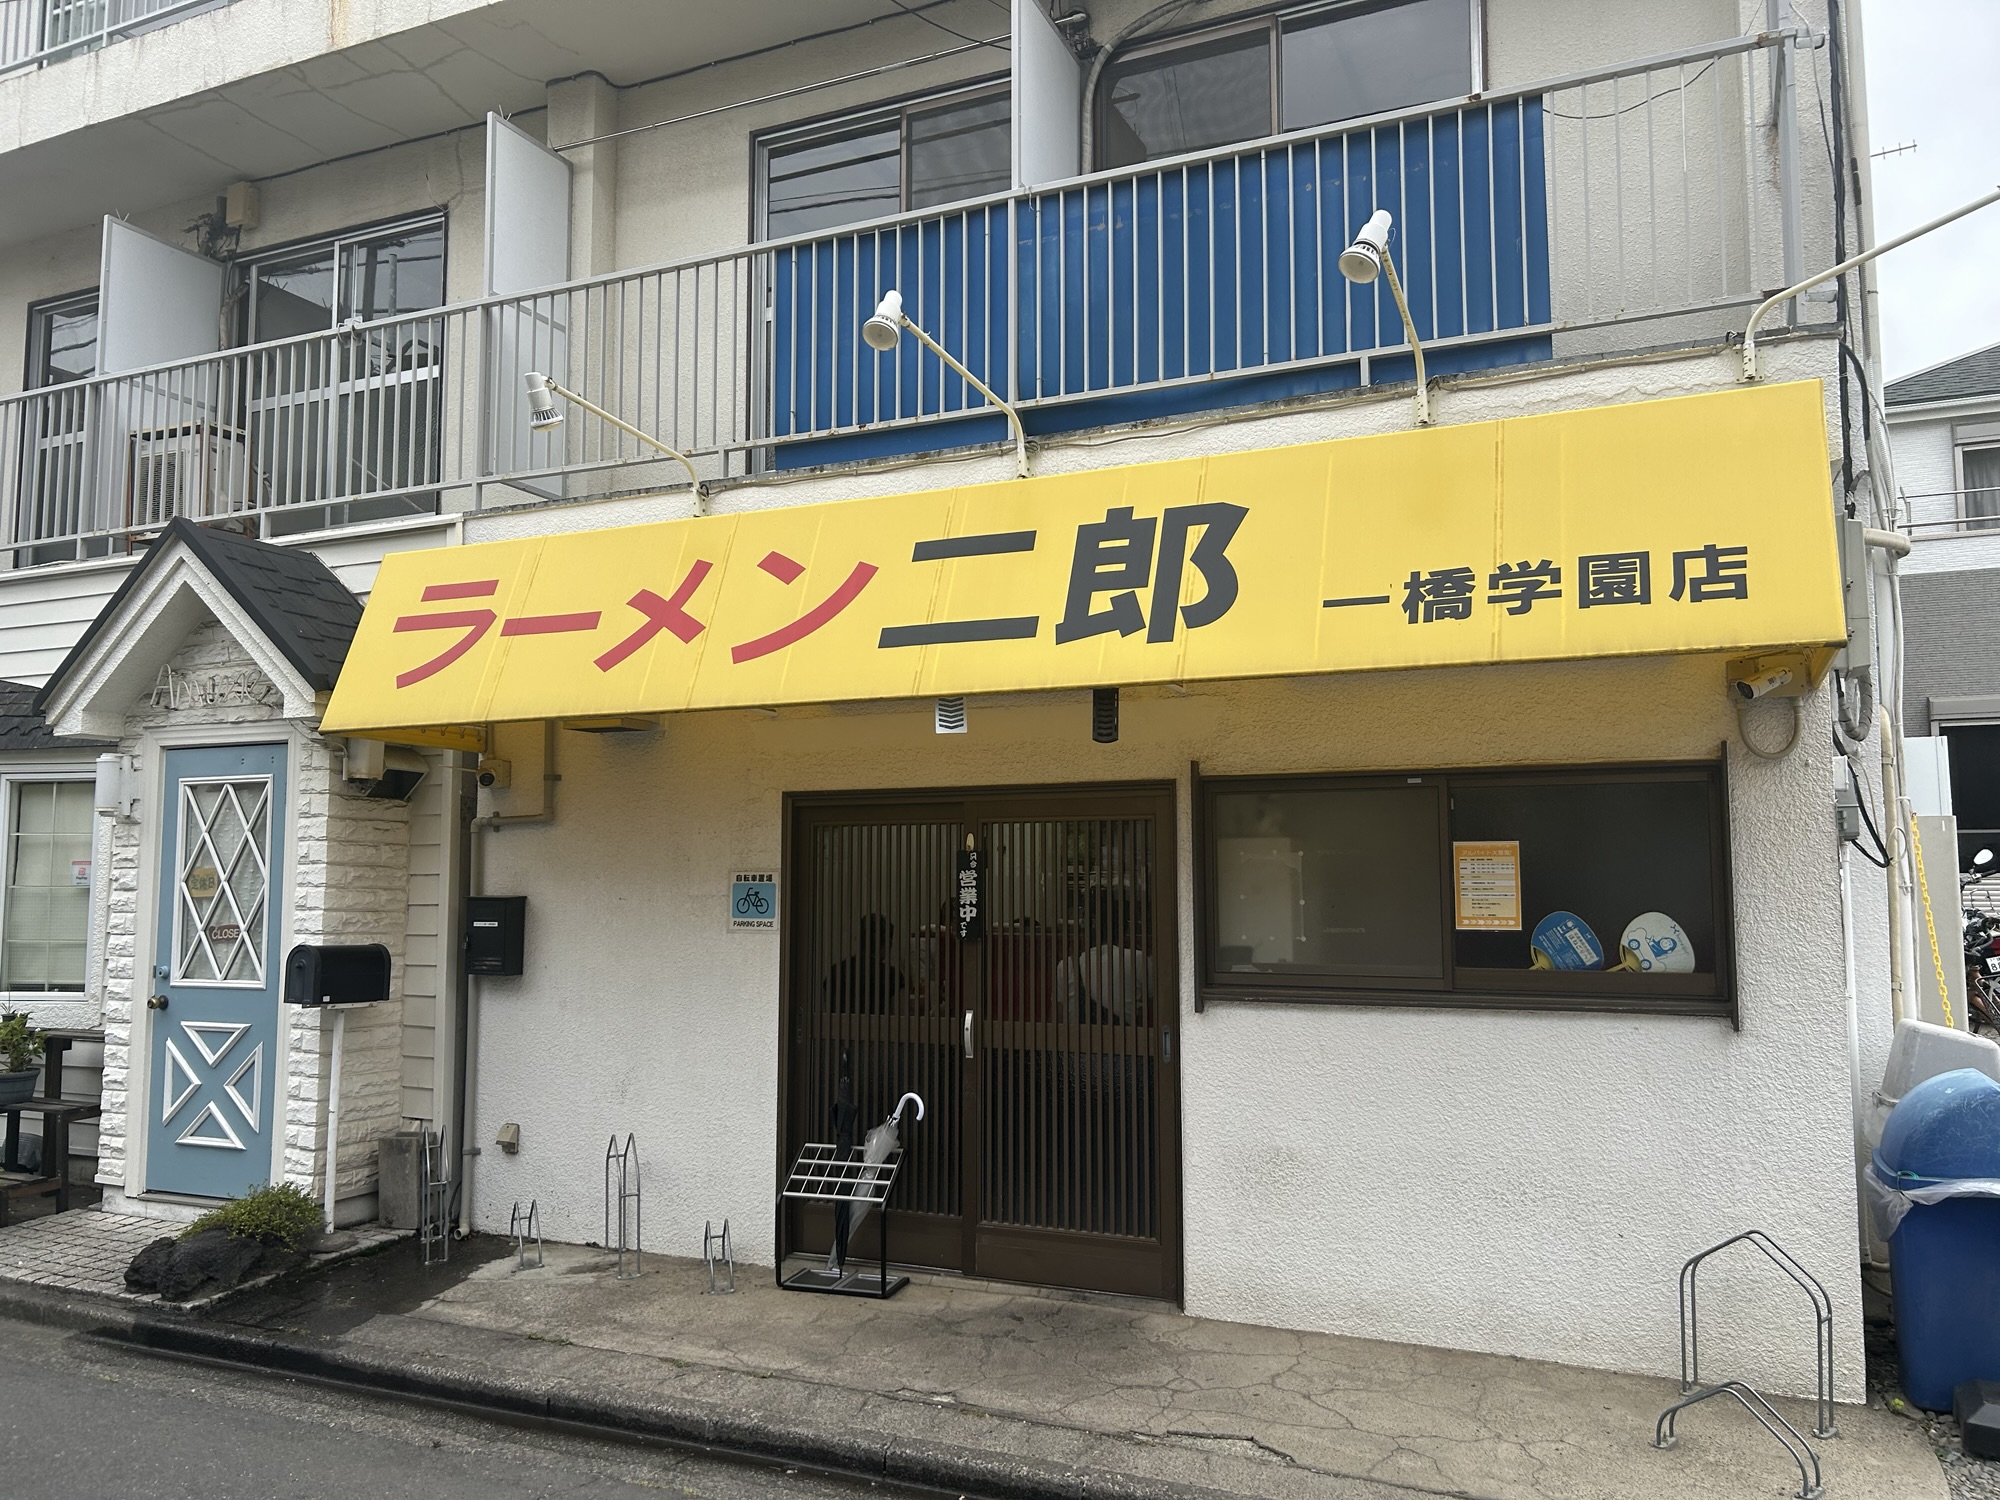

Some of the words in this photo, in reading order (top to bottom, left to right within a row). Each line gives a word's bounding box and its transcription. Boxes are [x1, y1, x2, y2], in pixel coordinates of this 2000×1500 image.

[1322, 543, 1749, 625] 一橋学園店
[733, 920, 756, 928] PARKING
